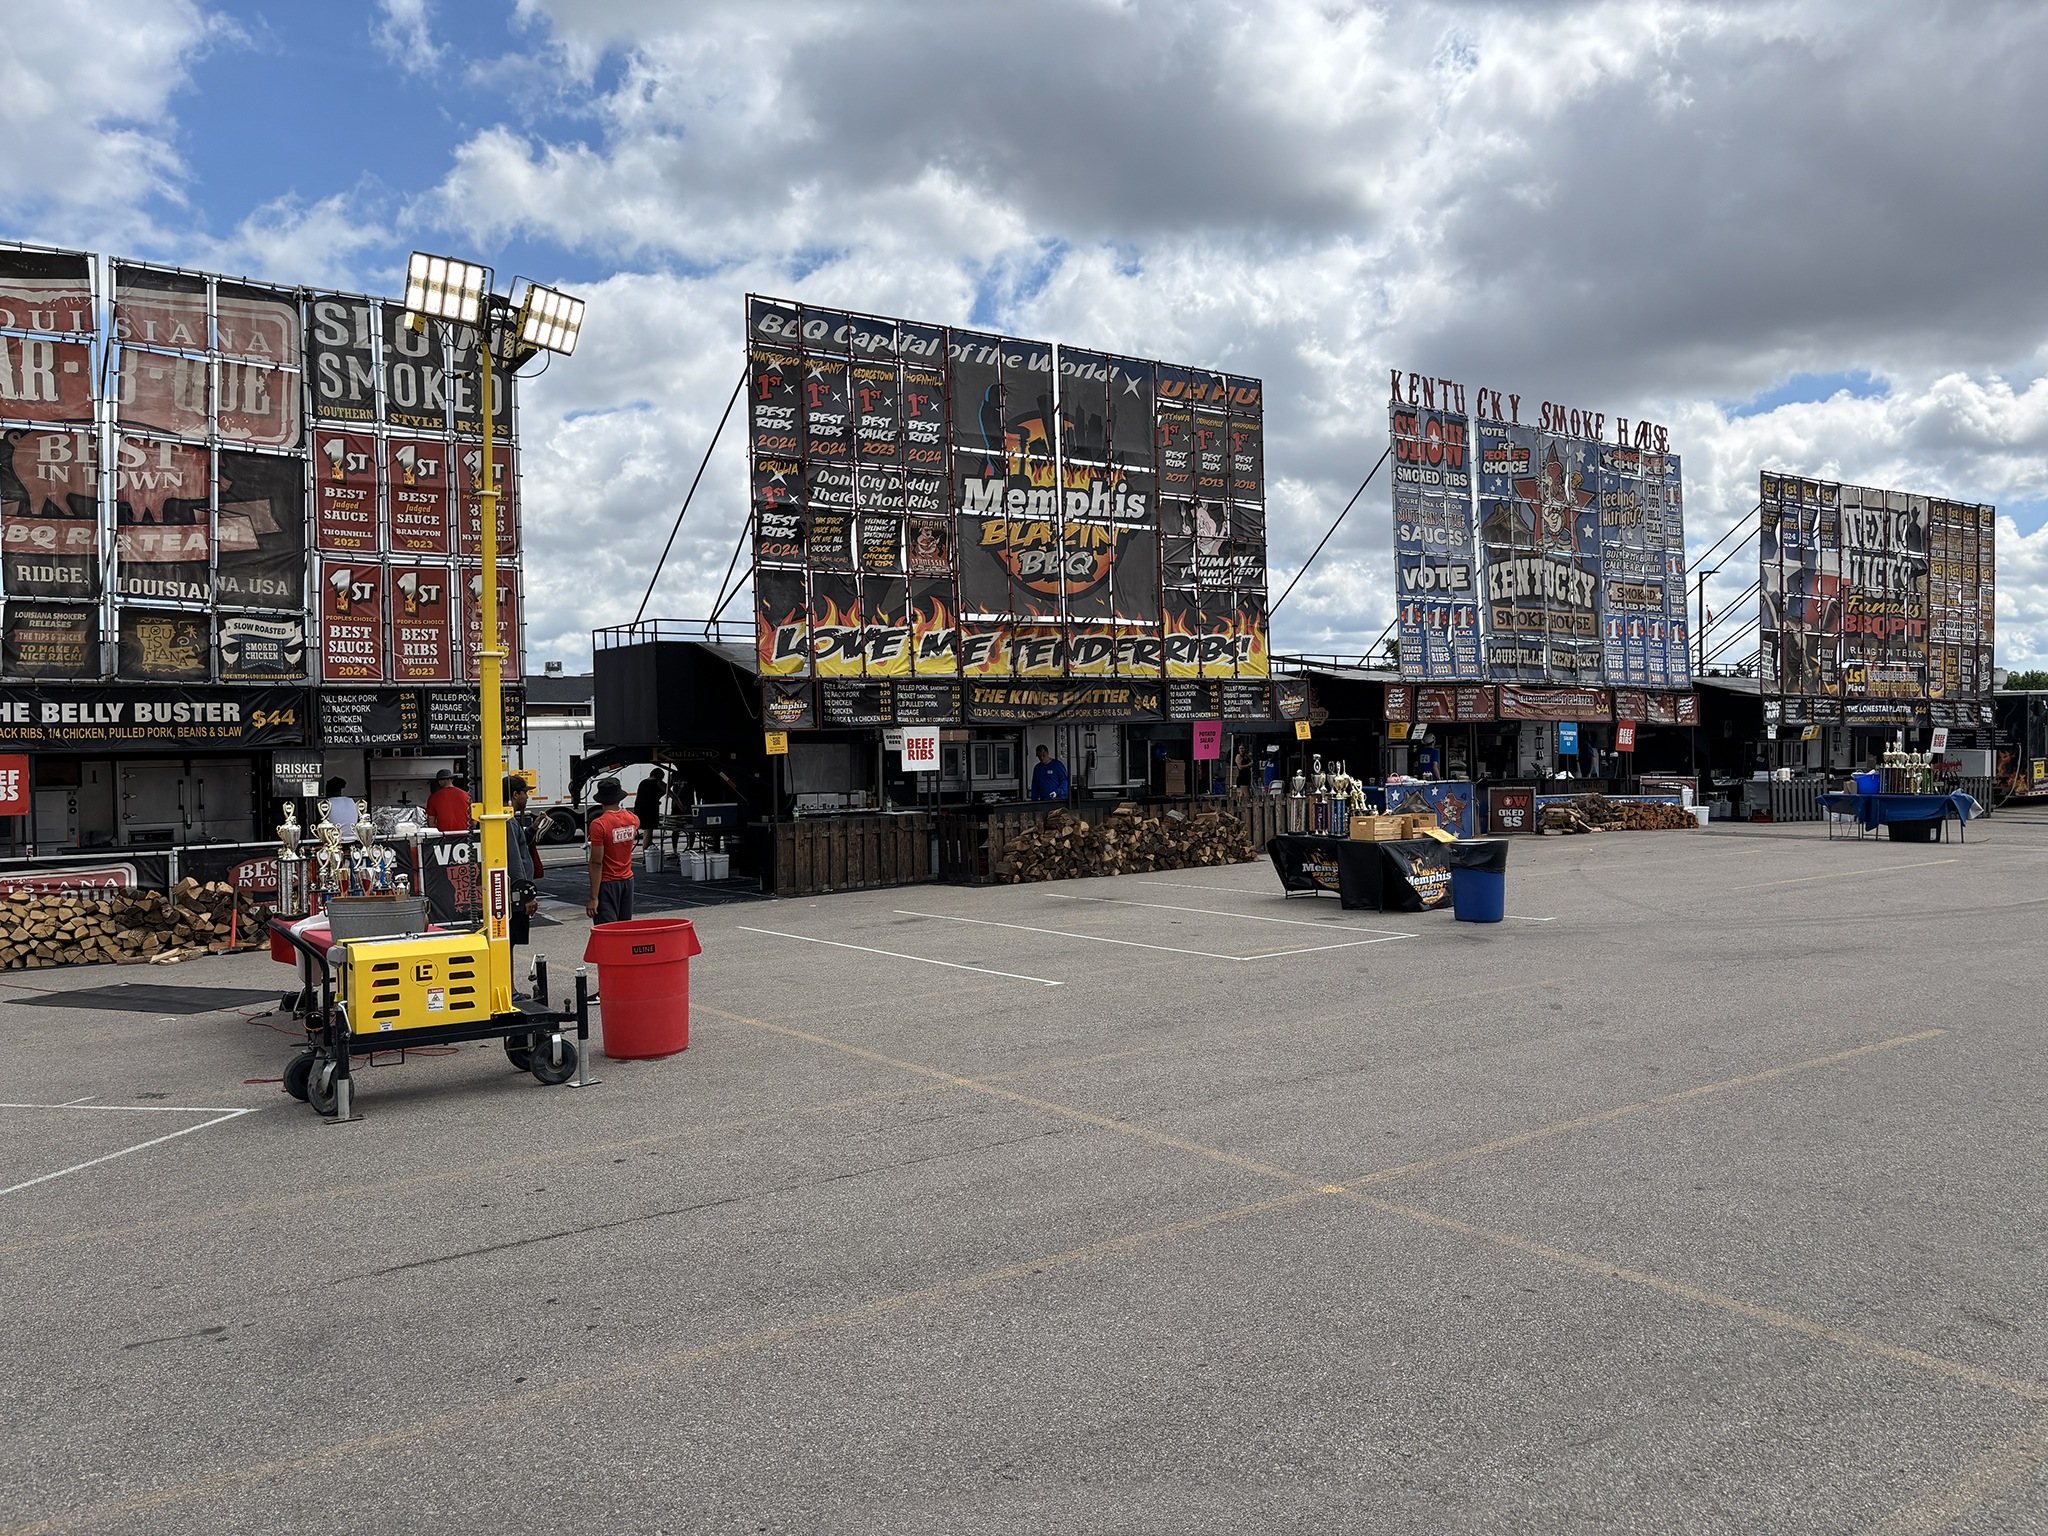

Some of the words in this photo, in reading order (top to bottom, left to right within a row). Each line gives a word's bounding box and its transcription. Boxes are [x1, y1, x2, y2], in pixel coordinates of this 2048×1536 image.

[832, 324, 941, 357] Capital
[975, 344, 1024, 370] the
[1026, 352, 1121, 384] World!
[317, 406, 374, 420] SOUTHERN
[390, 413, 444, 429] STYLE
[754, 404, 797, 420] BEST
[754, 417, 795, 433] RIBS
[808, 423, 845, 440] RIBS
[1538, 401, 1605, 442] SMOKE
[1616, 417, 1671, 454] HOUSE
[1479, 427, 1505, 439] VOTE
[757, 434, 798, 452] 2024
[861, 441, 896, 456] 2023
[907, 447, 943, 464] 2024
[36, 464, 70, 484] IN
[1483, 461, 1528, 476] CHOICE
[859, 475, 888, 491] Cry
[1165, 472, 1190, 484] 2017
[1198, 476, 1225, 489] 2013
[1397, 467, 1440, 487] SMOKED
[1233, 479, 1257, 491] 2018
[324, 487, 367, 501] BEST
[397, 491, 438, 504] BEST
[962, 476, 1148, 520] Memphis
[332, 500, 360, 511] Judged
[404, 503, 431, 515] Judged
[907, 494, 940, 511] Ribs
[324, 510, 368, 523] SAUCE
[1932, 505, 1944, 517] 1st
[397, 513, 440, 526] SAUCE
[322, 529, 373, 538] THORNHILL
[396, 528, 441, 538] BRAMPTON
[979, 519, 1131, 549] BLAZIN'
[1399, 525, 1464, 547] SAUCES
[333, 538, 361, 548] 2023
[406, 539, 433, 550] 2023
[1017, 549, 1096, 577] BBQ
[16, 565, 89, 586] RIDGE,
[248, 579, 290, 596] USA
[1402, 566, 1469, 593] VOTE
[1488, 558, 1597, 609] KENTUCKY
[1848, 595, 1922, 619] Famous
[14, 612, 53, 623] LOUISIANA
[53, 613, 87, 624] SMOKERS
[326, 615, 352, 623] PEOPLES
[29, 620, 72, 630] RELEASES
[234, 623, 252, 633] SLOW
[254, 624, 287, 636] ROASTED
[1844, 615, 1890, 640] BBQ
[1891, 618, 1927, 639] PIT
[18, 632, 34, 642] THE
[34, 633, 51, 643] TIPS
[329, 626, 372, 640] BEST
[401, 628, 439, 642] BEST
[21, 645, 33, 654] TO
[34, 646, 70, 655] MAKE
[73, 647, 80, 655] A
[245, 643, 278, 653] SMOKED
[328, 640, 374, 655] SAUCE
[403, 642, 438, 658] RIBS
[19, 653, 47, 663] NICE
[48, 653, 82, 663] RACK!
[245, 651, 279, 662] CHICKEN
[328, 656, 376, 666] TORONTO
[402, 657, 439, 666] ORILLIA
[338, 666, 368, 677] 2024
[408, 666, 435, 677] 2023
[1848, 668, 1867, 684] 1st
[1848, 683, 1866, 694] Place
[399, 693, 416, 702] $34
[431, 693, 457, 703] PULLED
[973, 688, 1008, 706] THE
[1008, 689, 1060, 708] KINGS
[1062, 688, 1130, 708] PLATTER
[1134, 693, 1159, 713] $44
[400, 702, 416, 711] $20
[430, 703, 463, 713] SAUSAGE
[769, 701, 808, 712] Memphis
[1847, 706, 1859, 714] THE
[41, 702, 124, 724] BELLY
[134, 702, 241, 723] BUSTER
[252, 708, 296, 729] $44
[332, 714, 362, 724] CHICKEN
[20, 727, 46, 741] RIBS,
[47, 728, 61, 740] 1/4
[62, 727, 107, 741] CHICKEN,
[109, 726, 145, 739] PULLED
[147, 726, 176, 740] PORK,
[177, 726, 207, 739] BEANS
[217, 726, 243, 739] SLAW
[430, 723, 454, 733] FAMILY
[1618, 728, 1634, 738] BEEF
[371, 733, 401, 744] CHICKEN
[906, 738, 936, 751] BEEF
[1618, 737, 1633, 746] RIBS
[1934, 734, 1946, 742] BEEF
[1933, 741, 1945, 749] RIBS
[907, 749, 936, 762] RIBS
[275, 763, 323, 774] BRISKET
[494, 873, 503, 910] BATTLEFIELD
[633, 945, 655, 955] ULINE
